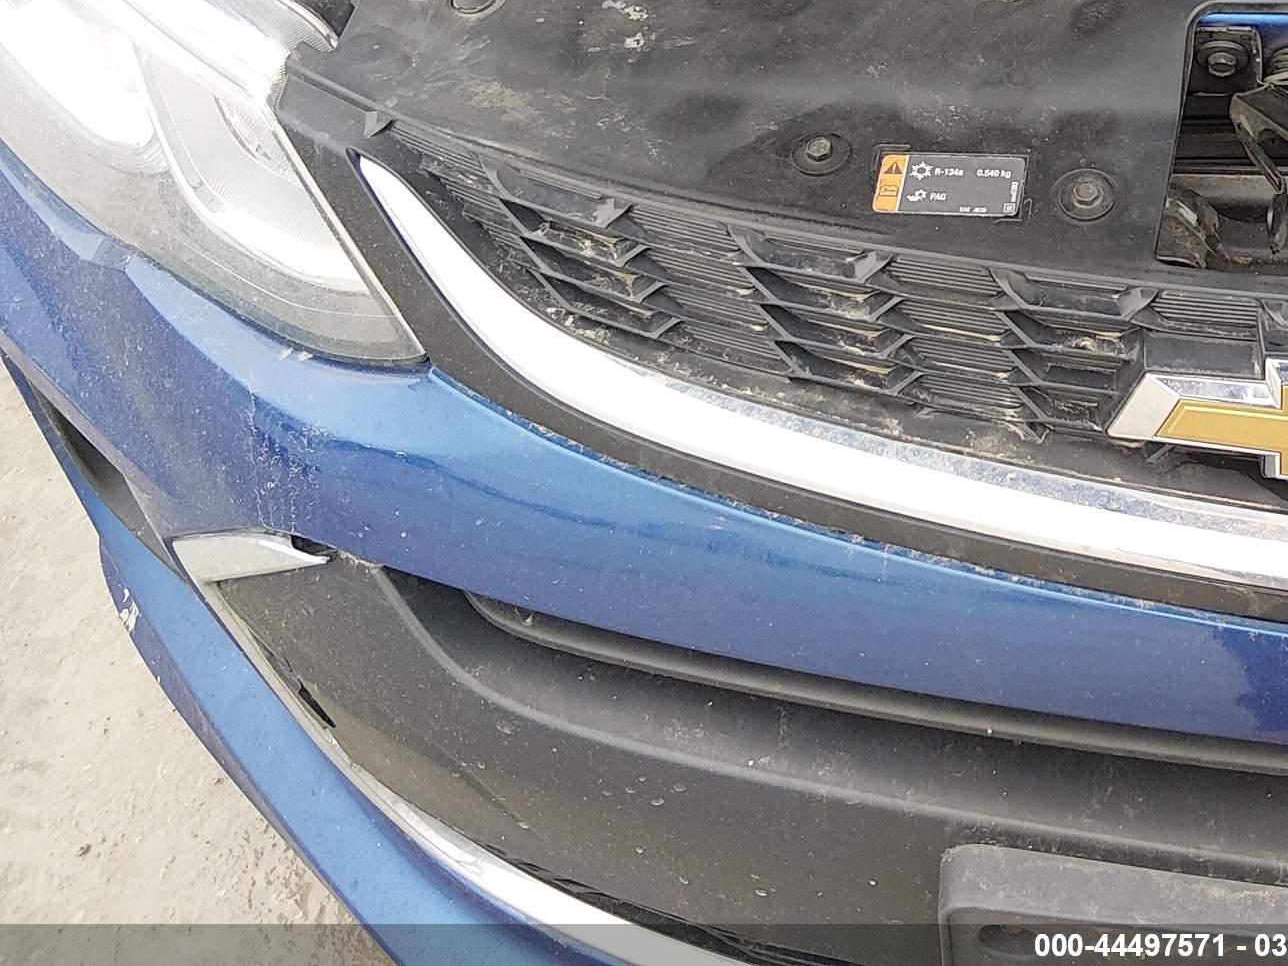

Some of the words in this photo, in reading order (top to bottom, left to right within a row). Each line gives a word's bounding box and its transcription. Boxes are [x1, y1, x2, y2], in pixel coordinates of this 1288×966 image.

[934, 167, 964, 177] R-134a
[976, 169, 1000, 177] 0.540
[1000, 169, 1012, 179] kg
